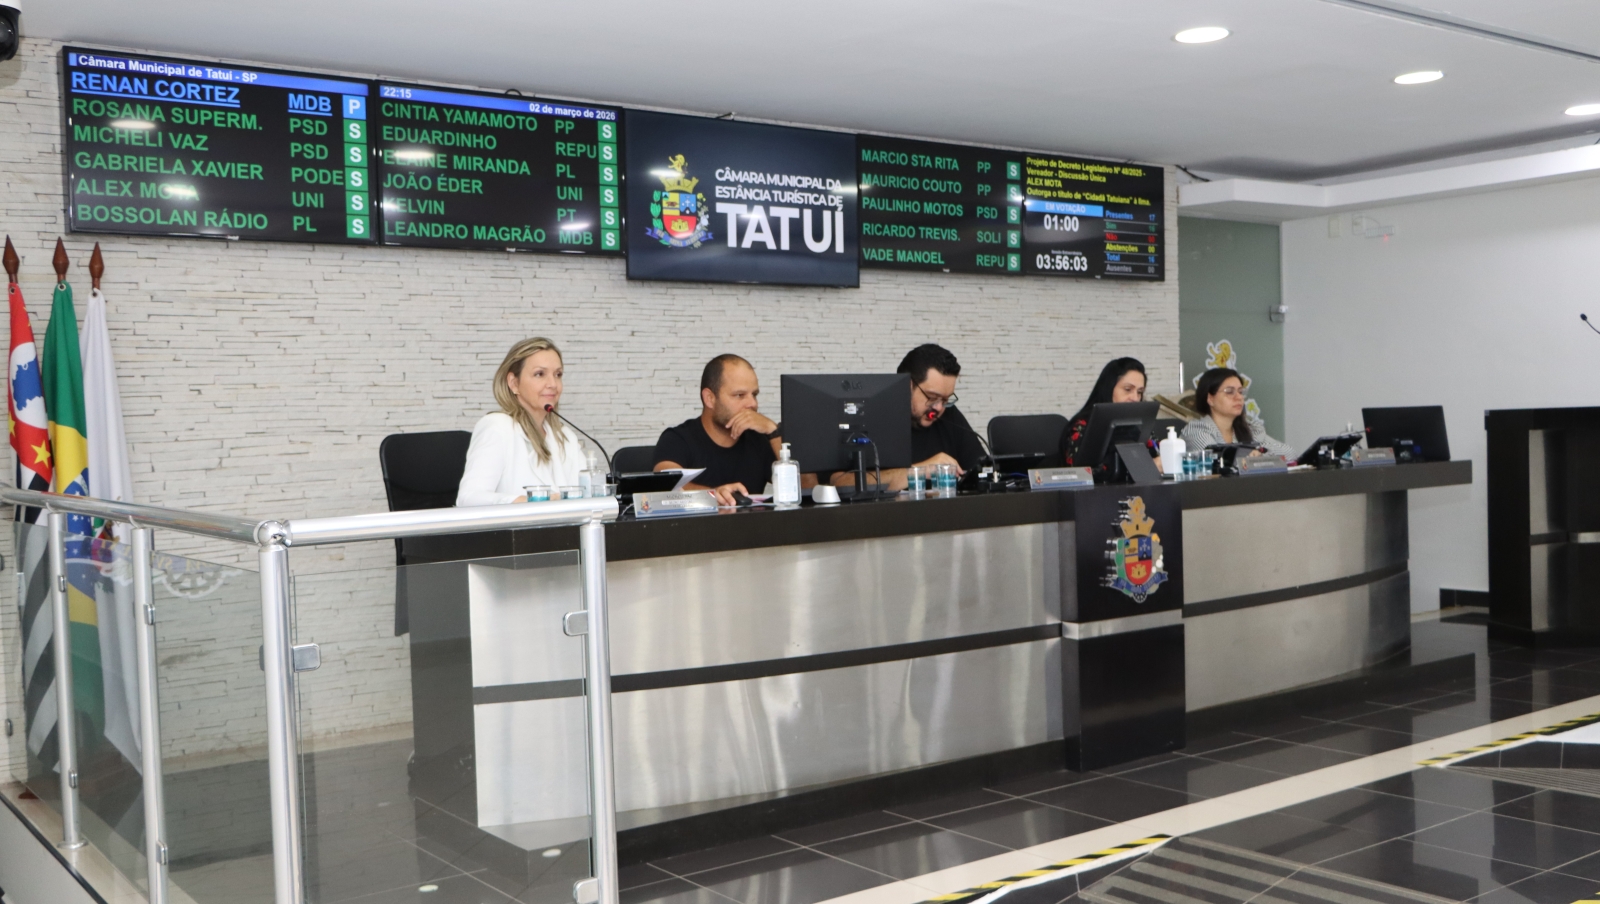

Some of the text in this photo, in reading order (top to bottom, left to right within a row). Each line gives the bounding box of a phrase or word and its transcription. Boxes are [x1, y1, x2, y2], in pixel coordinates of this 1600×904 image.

[78, 55, 126, 70] Câmara
[128, 60, 186, 77] Municipal
[188, 66, 202, 77] de
[242, 72, 258, 82] SP
[72, 72, 360, 114] RENAN CORTEZ MDB P
[383, 87, 412, 98] 22:15
[73, 98, 361, 138] ROSANA SUPERM. PSD S
[382, 102, 612, 138] CINTIA YAMAMOTO PP S
[529, 103, 616, 120] 02 de março de 2026
[74, 125, 362, 163] MICHELI VAZ PSD S
[382, 126, 613, 160] EDUARDINHO REPU S
[75, 151, 363, 187] GABRIELA XAVIER PODE S
[453, 154, 531, 175] MIRANDA
[556, 164, 575, 179] PL
[604, 168, 614, 182] S
[862, 149, 1018, 176] MARCIO STA RITA PP S
[1026, 157, 1048, 167] Projeto
[1049, 159, 1057, 167] de
[1058, 160, 1081, 170] Decreto
[1082, 163, 1113, 174] Legislativo
[715, 167, 842, 190] CÂMARA MUNICIPAL DA
[862, 173, 1018, 199] MAURICIO COUTO PP S
[1026, 167, 1053, 176] Vereador
[1058, 170, 1088, 181] Discussão
[1090, 172, 1106, 183] Única
[1027, 177, 1062, 188] ALEX MOTA
[76, 178, 363, 210] ALEX MOTA UNI S
[383, 171, 614, 203] JOÃO ÉDER UNI S
[715, 185, 843, 207] ESTÂNCIA TURÍSTICA DE
[1027, 187, 1051, 198] Outorga
[1074, 191, 1081, 199] de
[557, 208, 577, 222] PT
[605, 212, 615, 226] S
[862, 197, 1018, 221] PAULINHO MOTOS PSD S
[1045, 202, 1086, 213] EM VOTAÇÃO
[1105, 210, 1133, 220] Presentes
[77, 204, 364, 234] BOSSOLAN RÁDIO PL S
[716, 202, 844, 253] TATUÍ
[1043, 214, 1080, 232] 01:00
[1105, 221, 1117, 230] Sim
[384, 221, 616, 247] LEANDRO MAGRÃO MDB S
[863, 223, 1018, 245] RICARDO TREVIS. SOLI S
[1105, 232, 1118, 240] Não
[863, 248, 1018, 268] VADE MANOEL REPU S
[1105, 242, 1138, 253] Abstenções
[1106, 253, 1121, 261] Total
[1036, 253, 1088, 271] 03:56:03
[1106, 263, 1132, 273] Ausentes
